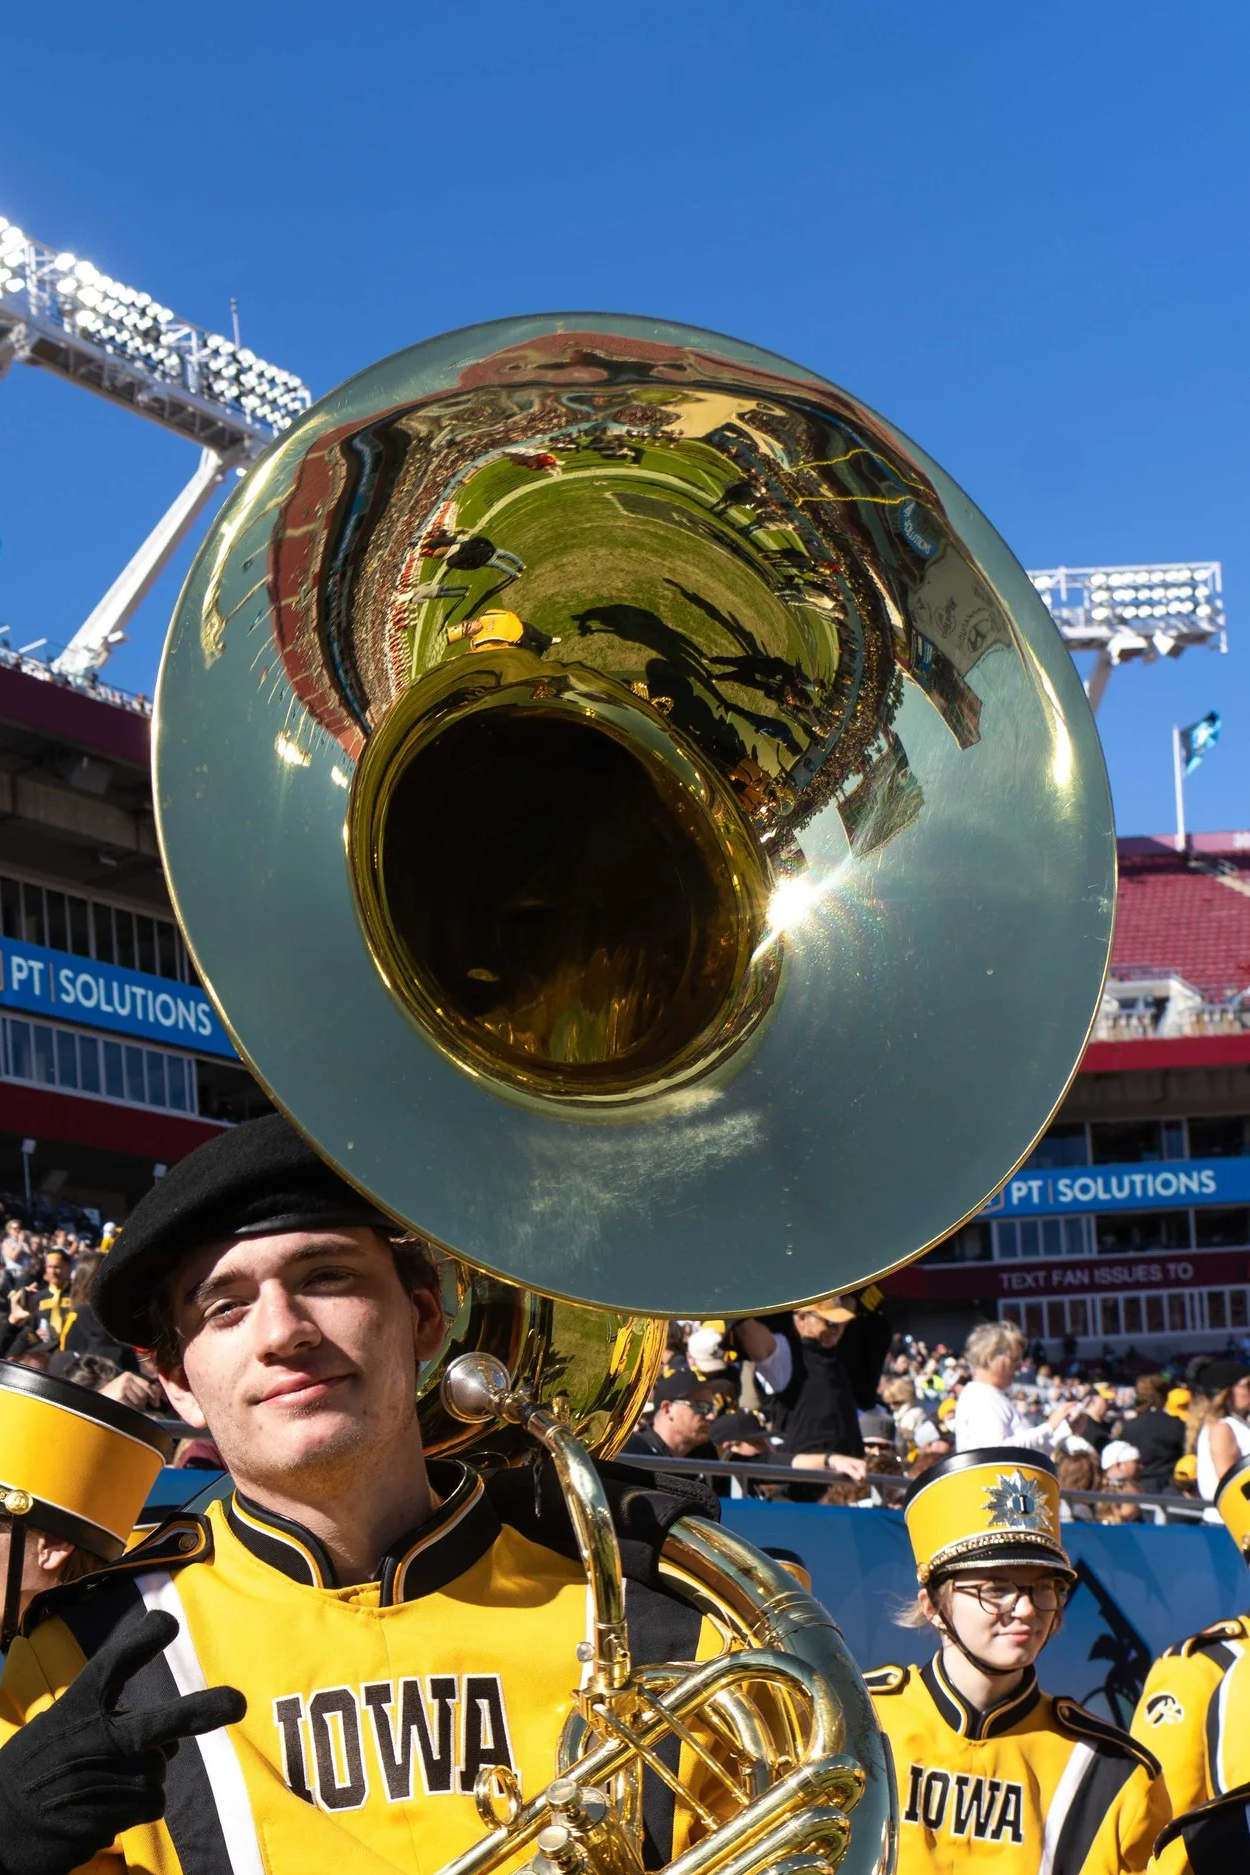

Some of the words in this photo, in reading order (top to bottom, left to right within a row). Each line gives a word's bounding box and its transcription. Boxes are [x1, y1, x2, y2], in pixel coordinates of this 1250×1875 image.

[11, 955, 44, 996] PT
[60, 972, 213, 1036] SOLUTIONS
[1011, 1180, 1043, 1205] PT
[1058, 1170, 1217, 1203] SOLUTIONS
[1000, 1270, 1047, 1290] TEXT
[1052, 1268, 1090, 1287] FAN
[1094, 1264, 1163, 1285] ISSUES
[1166, 1261, 1194, 1281] TO
[273, 1673, 522, 1813] IOWA
[900, 1763, 1024, 1846] IOWA
